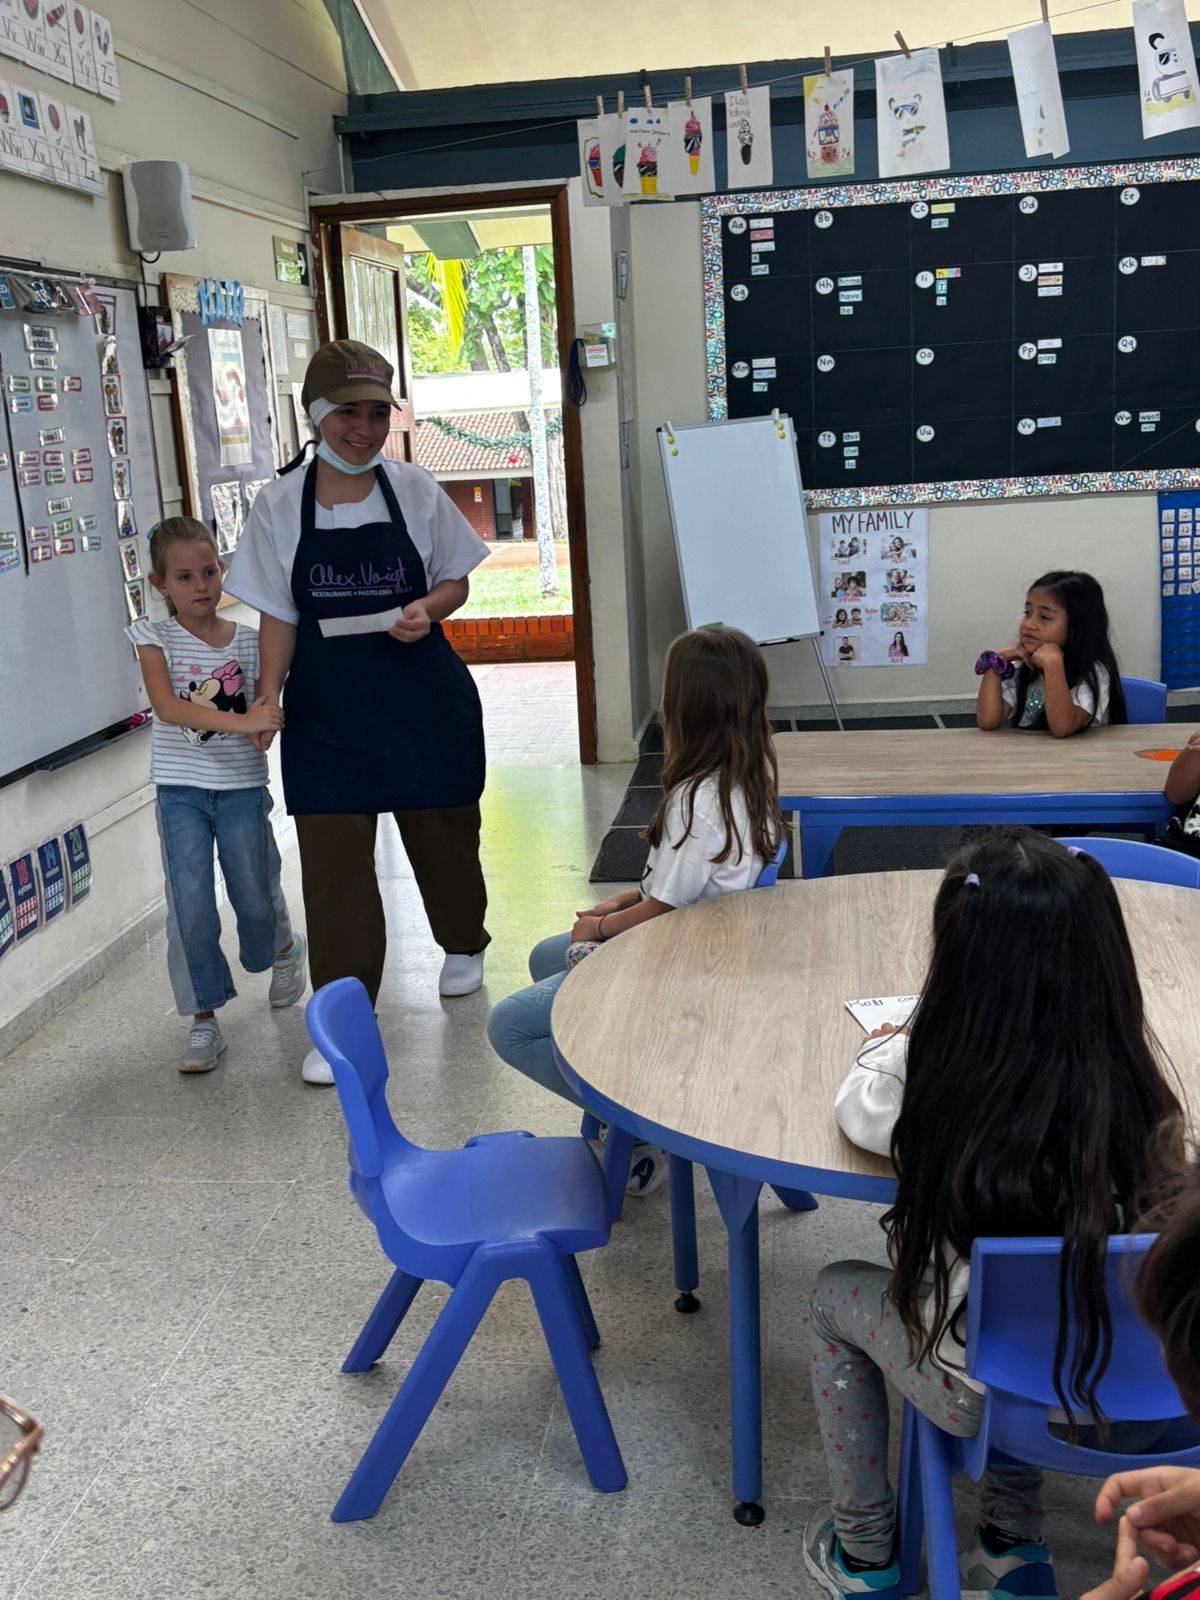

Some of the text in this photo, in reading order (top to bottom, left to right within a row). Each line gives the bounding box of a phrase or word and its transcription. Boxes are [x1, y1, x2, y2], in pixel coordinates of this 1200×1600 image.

[1124, 191, 1135, 200] Ee
[914, 204, 926, 213] Cc
[1021, 200, 1035, 210] Dd
[818, 213, 830, 223] Bb
[932, 219, 948, 227] can
[732, 220, 744, 230] Aa
[1121, 258, 1135, 269] Kk
[1024, 266, 1033, 280] Jj
[818, 281, 832, 289] Hh
[733, 287, 745, 298] Gg
[1121, 339, 1135, 350] Qq
[920, 351, 932, 359] Oo
[1022, 346, 1034, 358] Pp
[820, 358, 833, 367] Nn
[1038, 354, 1056, 364] play
[733, 365, 749, 373] Mm
[1115, 413, 1132, 422] Ww
[1020, 421, 1032, 429] Vv
[920, 427, 932, 436] Uu
[821, 433, 832, 443] Tt
[832, 511, 914, 534] MY FAMILY
[310, 563, 357, 586] Alex
[312, 590, 353, 598] RESTAURANTE
[69, 828, 82, 854] 20
[15, 860, 28, 885] 18
